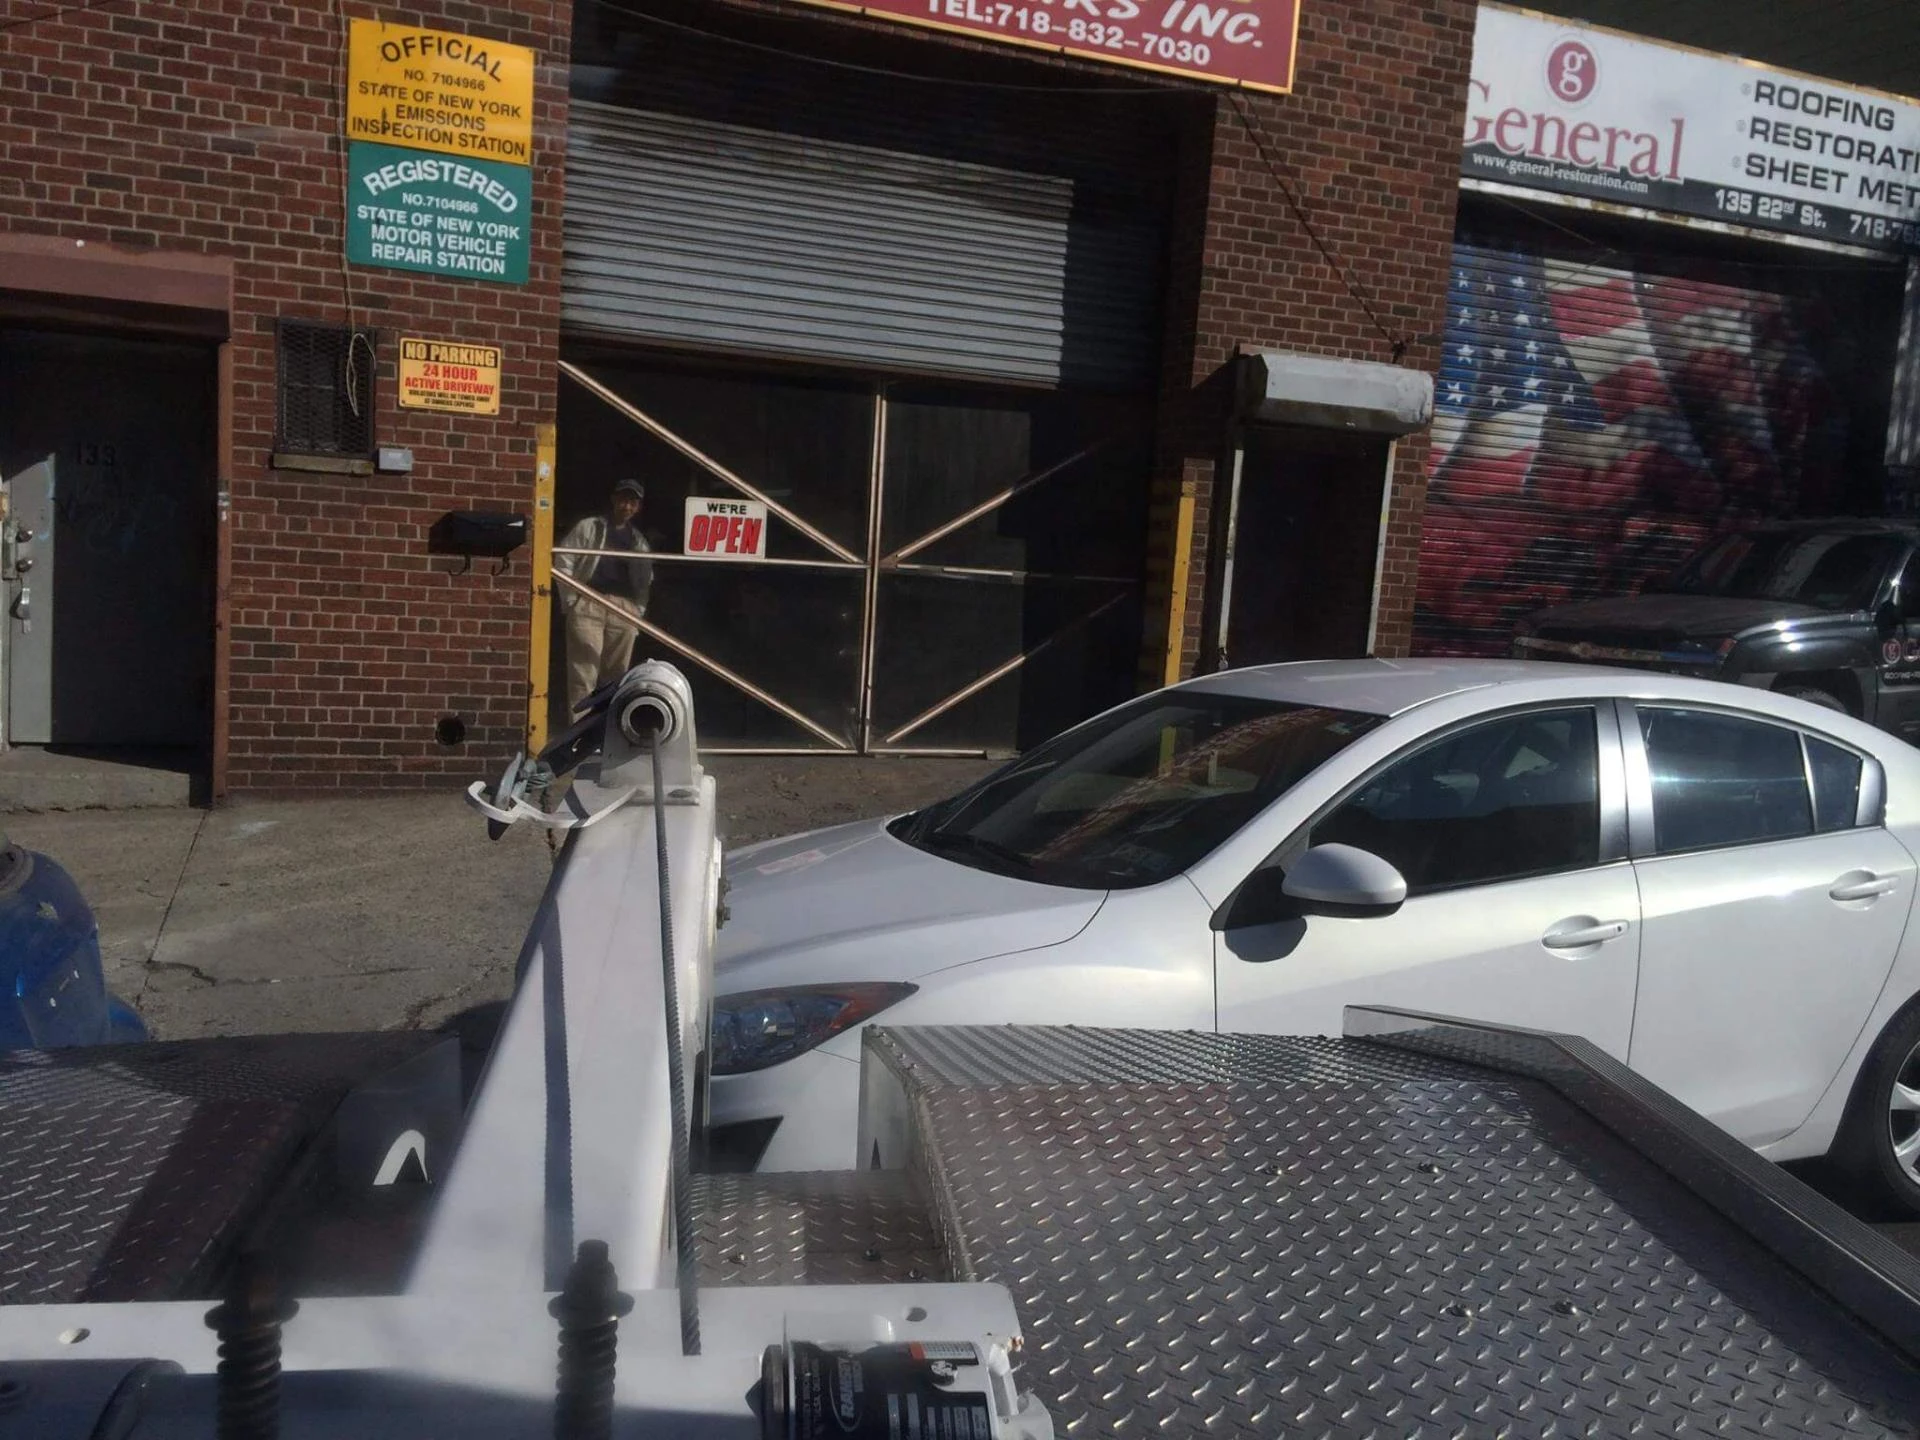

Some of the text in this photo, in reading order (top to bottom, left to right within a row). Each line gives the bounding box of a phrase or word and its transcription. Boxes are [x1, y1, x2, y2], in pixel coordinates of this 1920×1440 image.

[1160, 0, 1263, 47] INC.
[381, 36, 502, 82] OFFICIAL
[1559, 51, 1587, 95] g
[404, 69, 486, 91] NO. 7104966
[359, 81, 521, 118] STATE OF NEW YORK
[1754, 79, 1895, 132] ROOFING
[396, 105, 486, 131] EMISSIONS
[352, 117, 525, 156] INSPECTION STATION
[363, 160, 518, 213] REGISTERED
[1472, 152, 1649, 194] www.general-restoration.com
[1745, 153, 1920, 208] SHEET MET
[1715, 189, 1753, 214] 135
[357, 205, 520, 240] STATE OF NEW YORK
[371, 224, 507, 256] MOTOR VEHICLE
[371, 243, 505, 274] REPAIR STATION
[405, 342, 496, 367] NO PARKING
[423, 364, 478, 381] 24 HOUR
[405, 377, 495, 395] ACTIVE DRIVEWAY
[707, 503, 747, 515] WE'RE
[689, 514, 763, 554] OPEN
